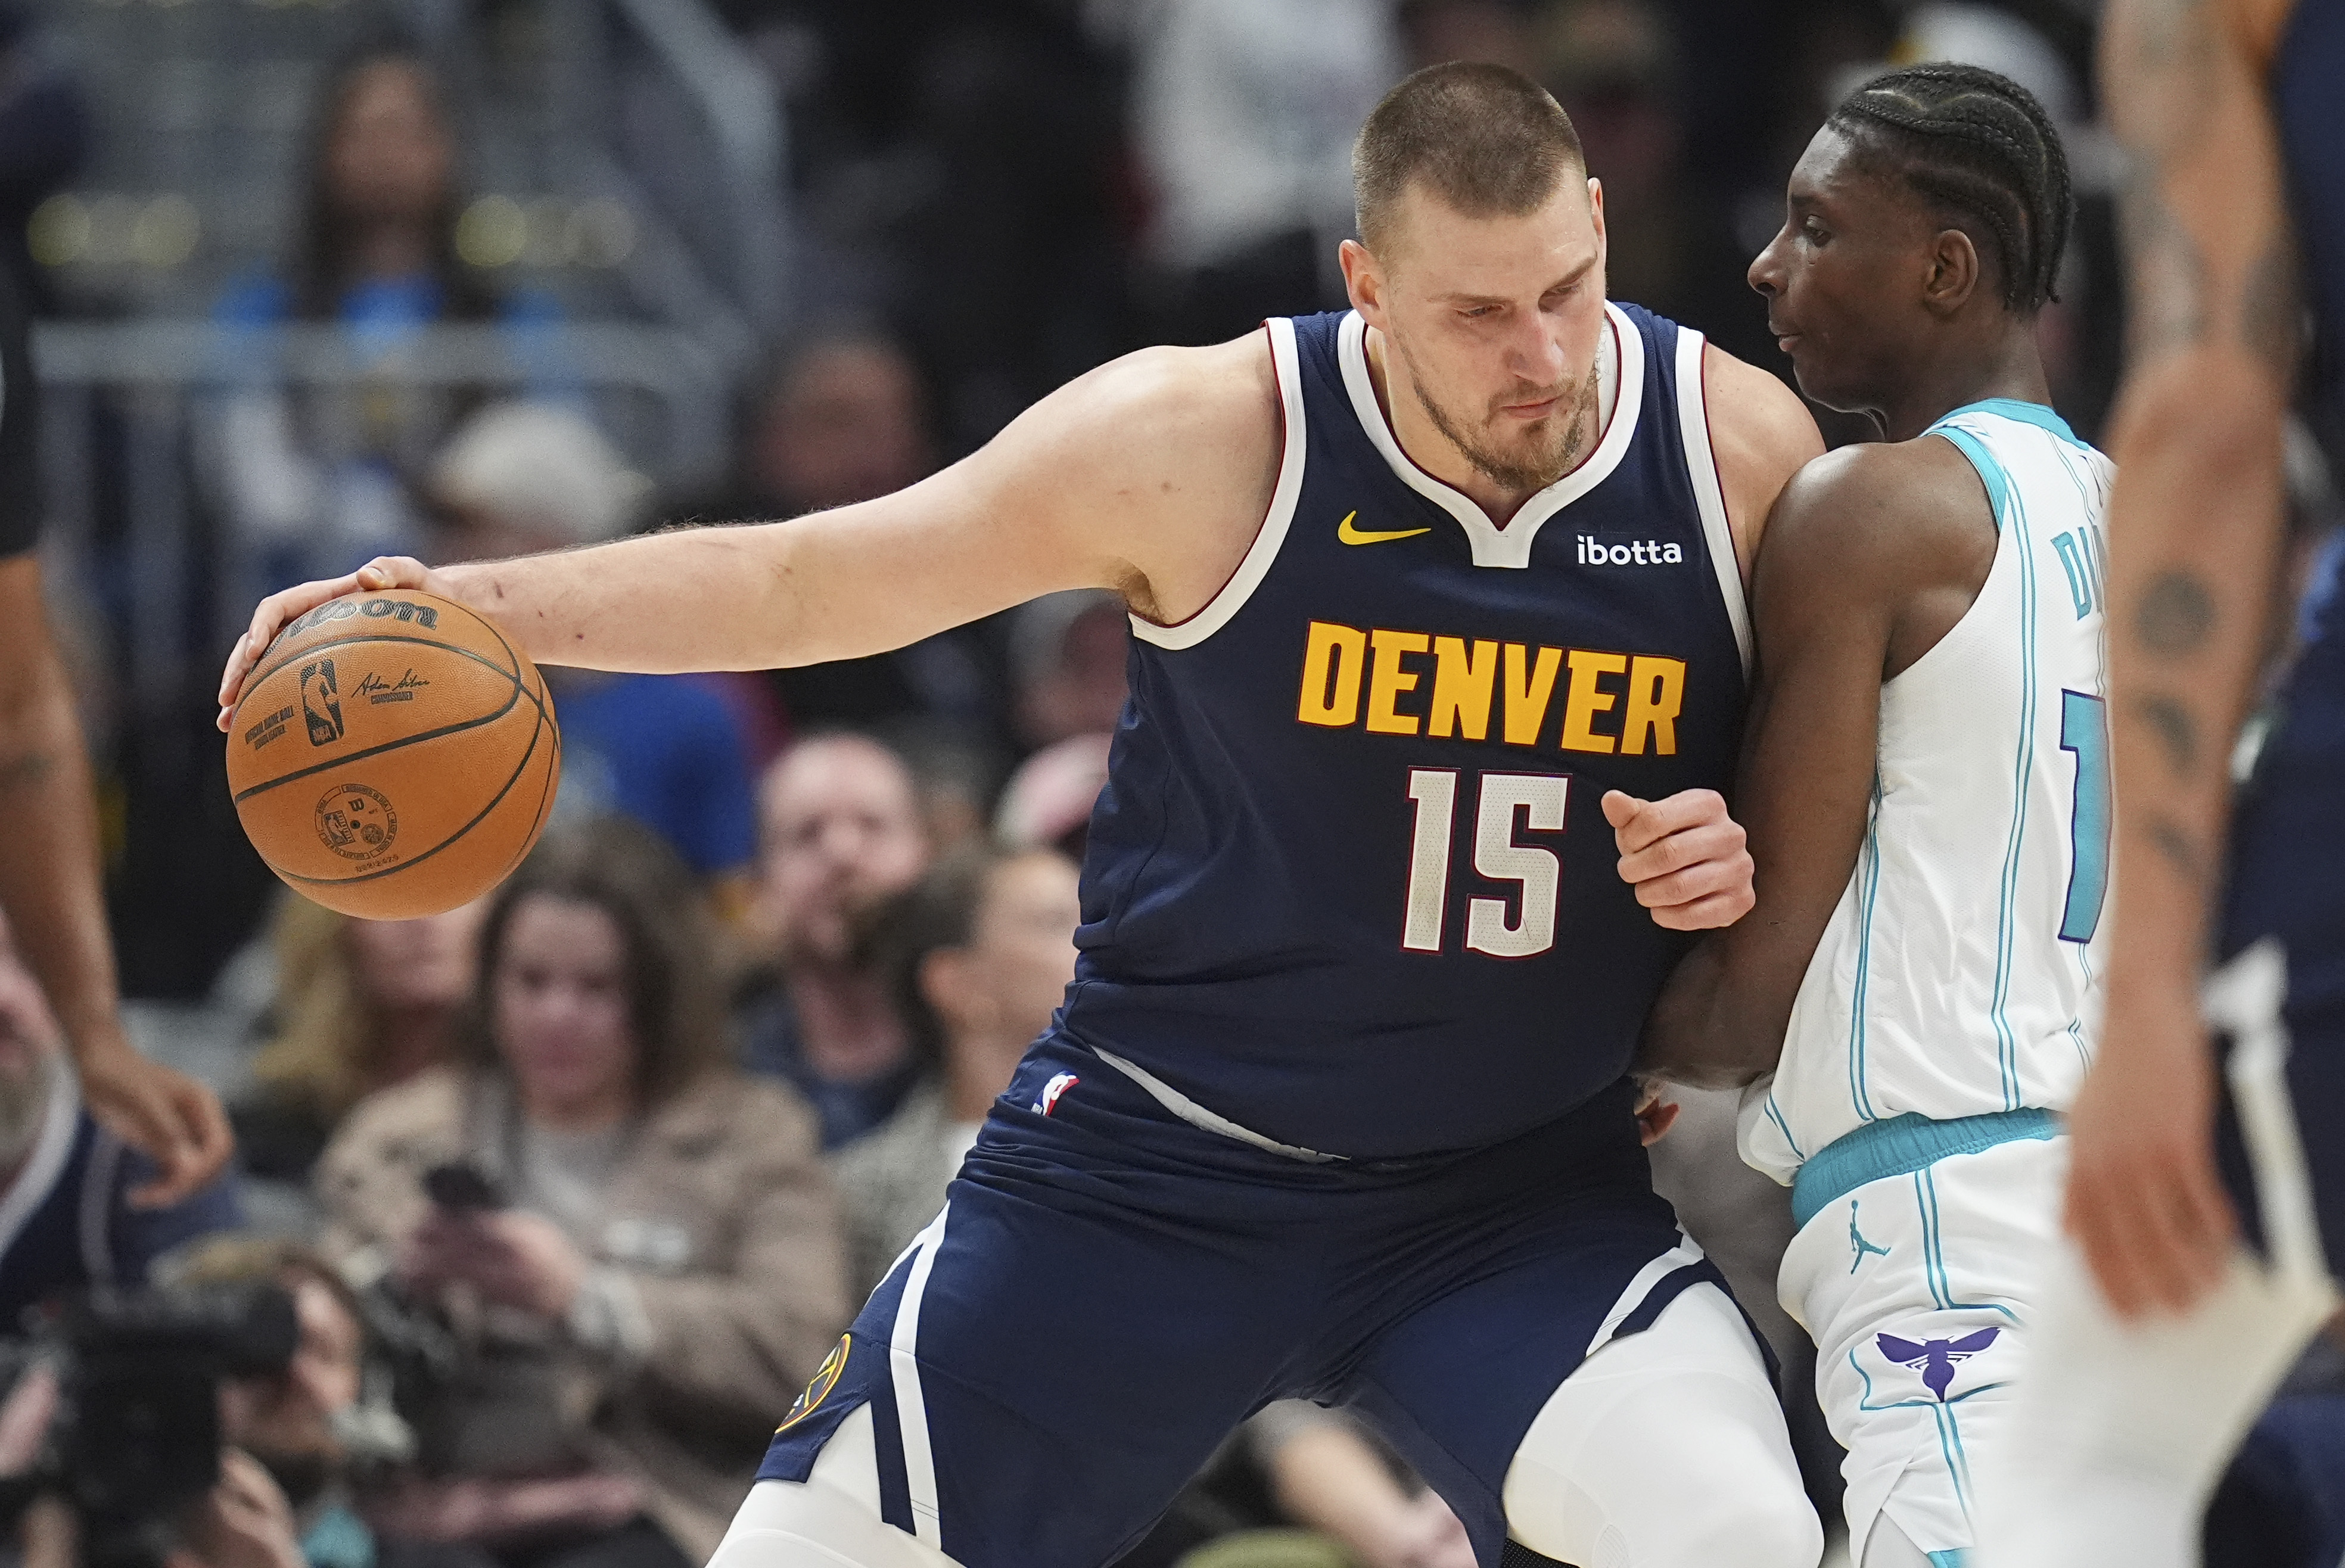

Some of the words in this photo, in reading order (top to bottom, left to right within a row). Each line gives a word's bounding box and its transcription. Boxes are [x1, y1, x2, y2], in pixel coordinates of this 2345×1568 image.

[1578, 534, 1682, 565] ibotta
[1296, 618, 1688, 756] DENVER
[1401, 766, 1573, 961] 15
